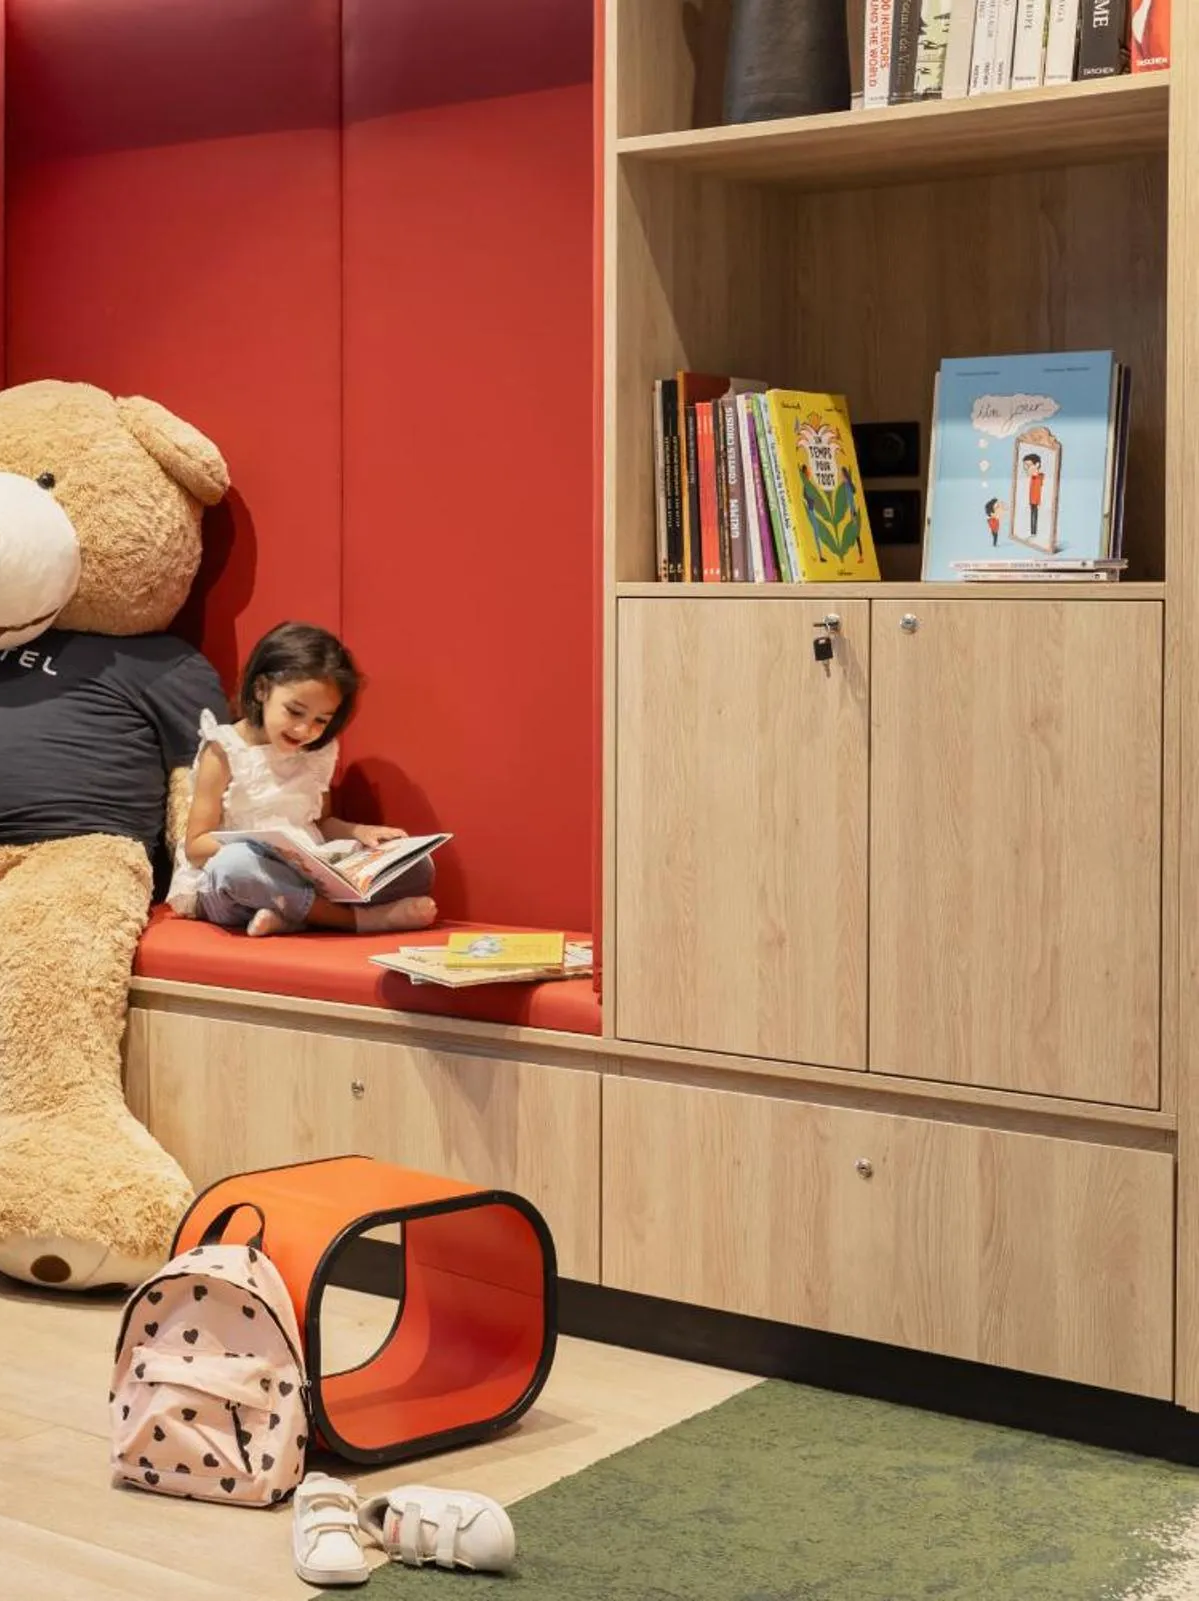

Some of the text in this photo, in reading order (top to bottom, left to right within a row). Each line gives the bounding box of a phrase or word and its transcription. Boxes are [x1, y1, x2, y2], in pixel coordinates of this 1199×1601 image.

[869, 26, 879, 45] THE
[880, 14, 891, 69] INTERIORS
[868, 48, 879, 88] WORLD
[808, 446, 832, 460] TEMPS
[725, 407, 740, 538] GRIMM CONTES CHOISIS
[815, 460, 831, 472] POUR
[816, 473, 835, 486] TOUT
